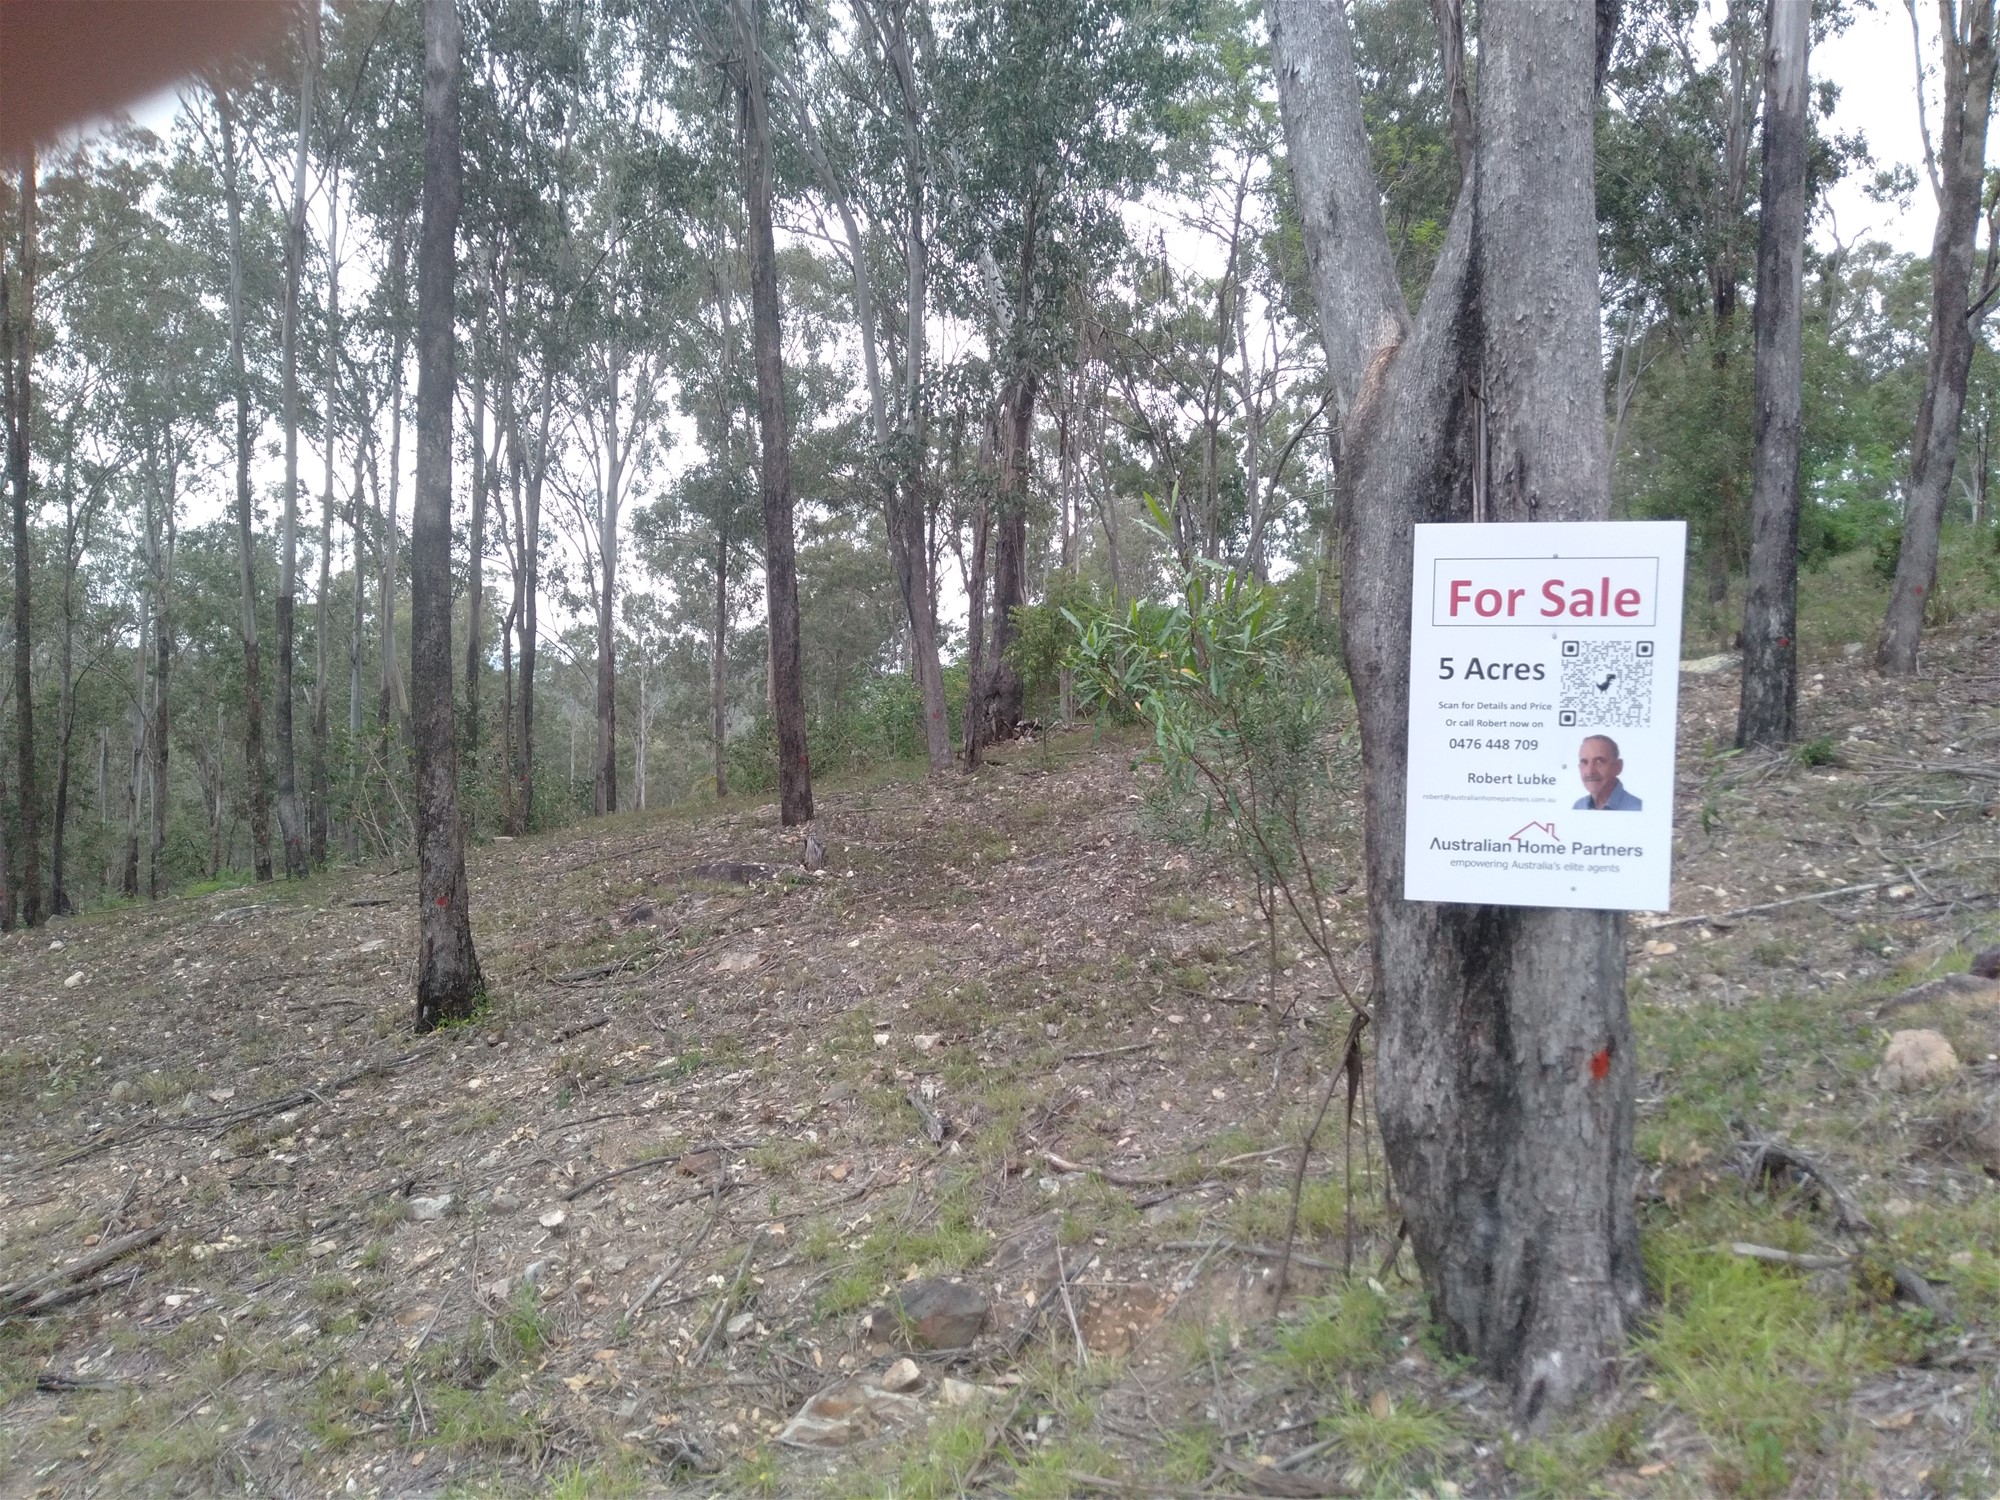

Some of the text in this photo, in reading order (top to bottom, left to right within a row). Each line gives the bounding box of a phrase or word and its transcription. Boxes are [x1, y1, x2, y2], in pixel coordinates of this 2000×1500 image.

[1449, 577, 1641, 617] For Sale
[1439, 657, 1545, 680] 5 Acres
[1439, 702, 1552, 711] Scan for Details and Price
[1446, 719, 1457, 727] Or
[1459, 719, 1474, 727] call
[1449, 739, 1538, 750] 0476 448 709
[1468, 773, 1556, 785] Robert Lubke
[1423, 794, 1556, 803] robert@australianhomepartners.com.au
[1430, 837, 1643, 857] Australian Home Partners
[1450, 858, 1620, 873] empowering Australia's elite agents
